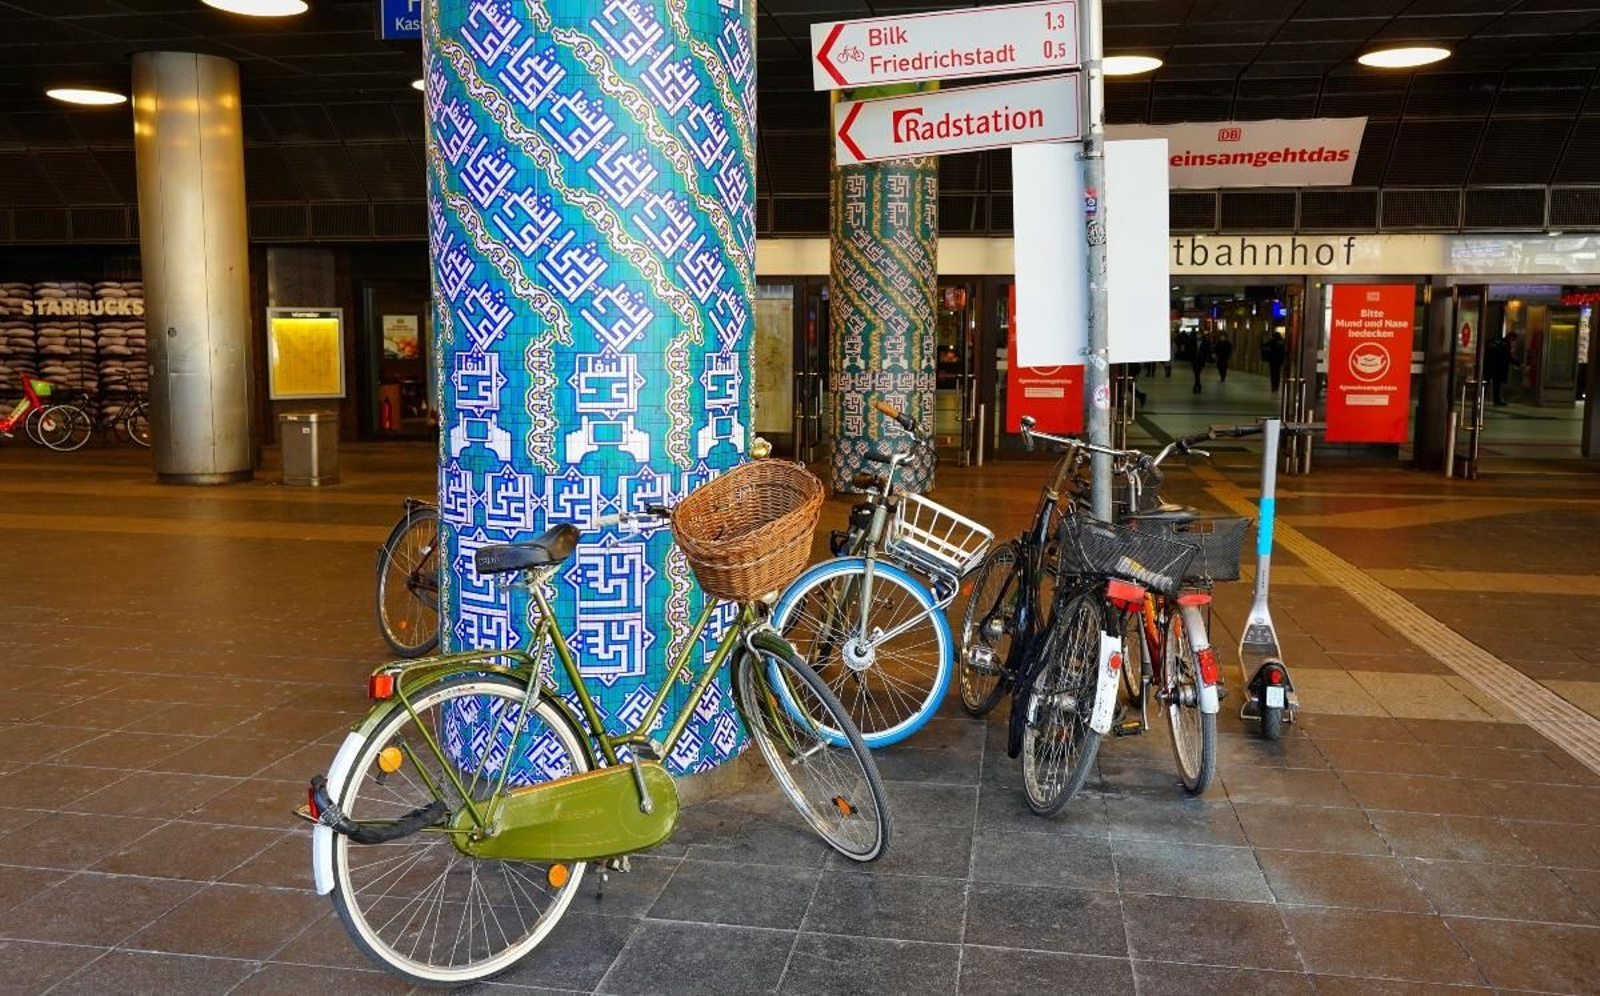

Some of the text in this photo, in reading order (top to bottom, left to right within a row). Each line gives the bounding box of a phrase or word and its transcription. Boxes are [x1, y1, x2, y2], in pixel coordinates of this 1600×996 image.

[395, 17, 421, 31] Kas
[868, 26, 908, 46] Bilk
[870, 44, 1016, 75] Friedrichstadt
[905, 106, 1044, 142] Radstation
[1220, 129, 1240, 141] DB
[1170, 147, 1350, 167] einsamgehtdas
[1173, 237, 1355, 266] tbahnhof
[22, 299, 145, 316] STARBUCKS
[1360, 308, 1385, 318] Bitte
[1335, 319, 1409, 328] Mund und Nase
[1348, 329, 1395, 338] bedecken
